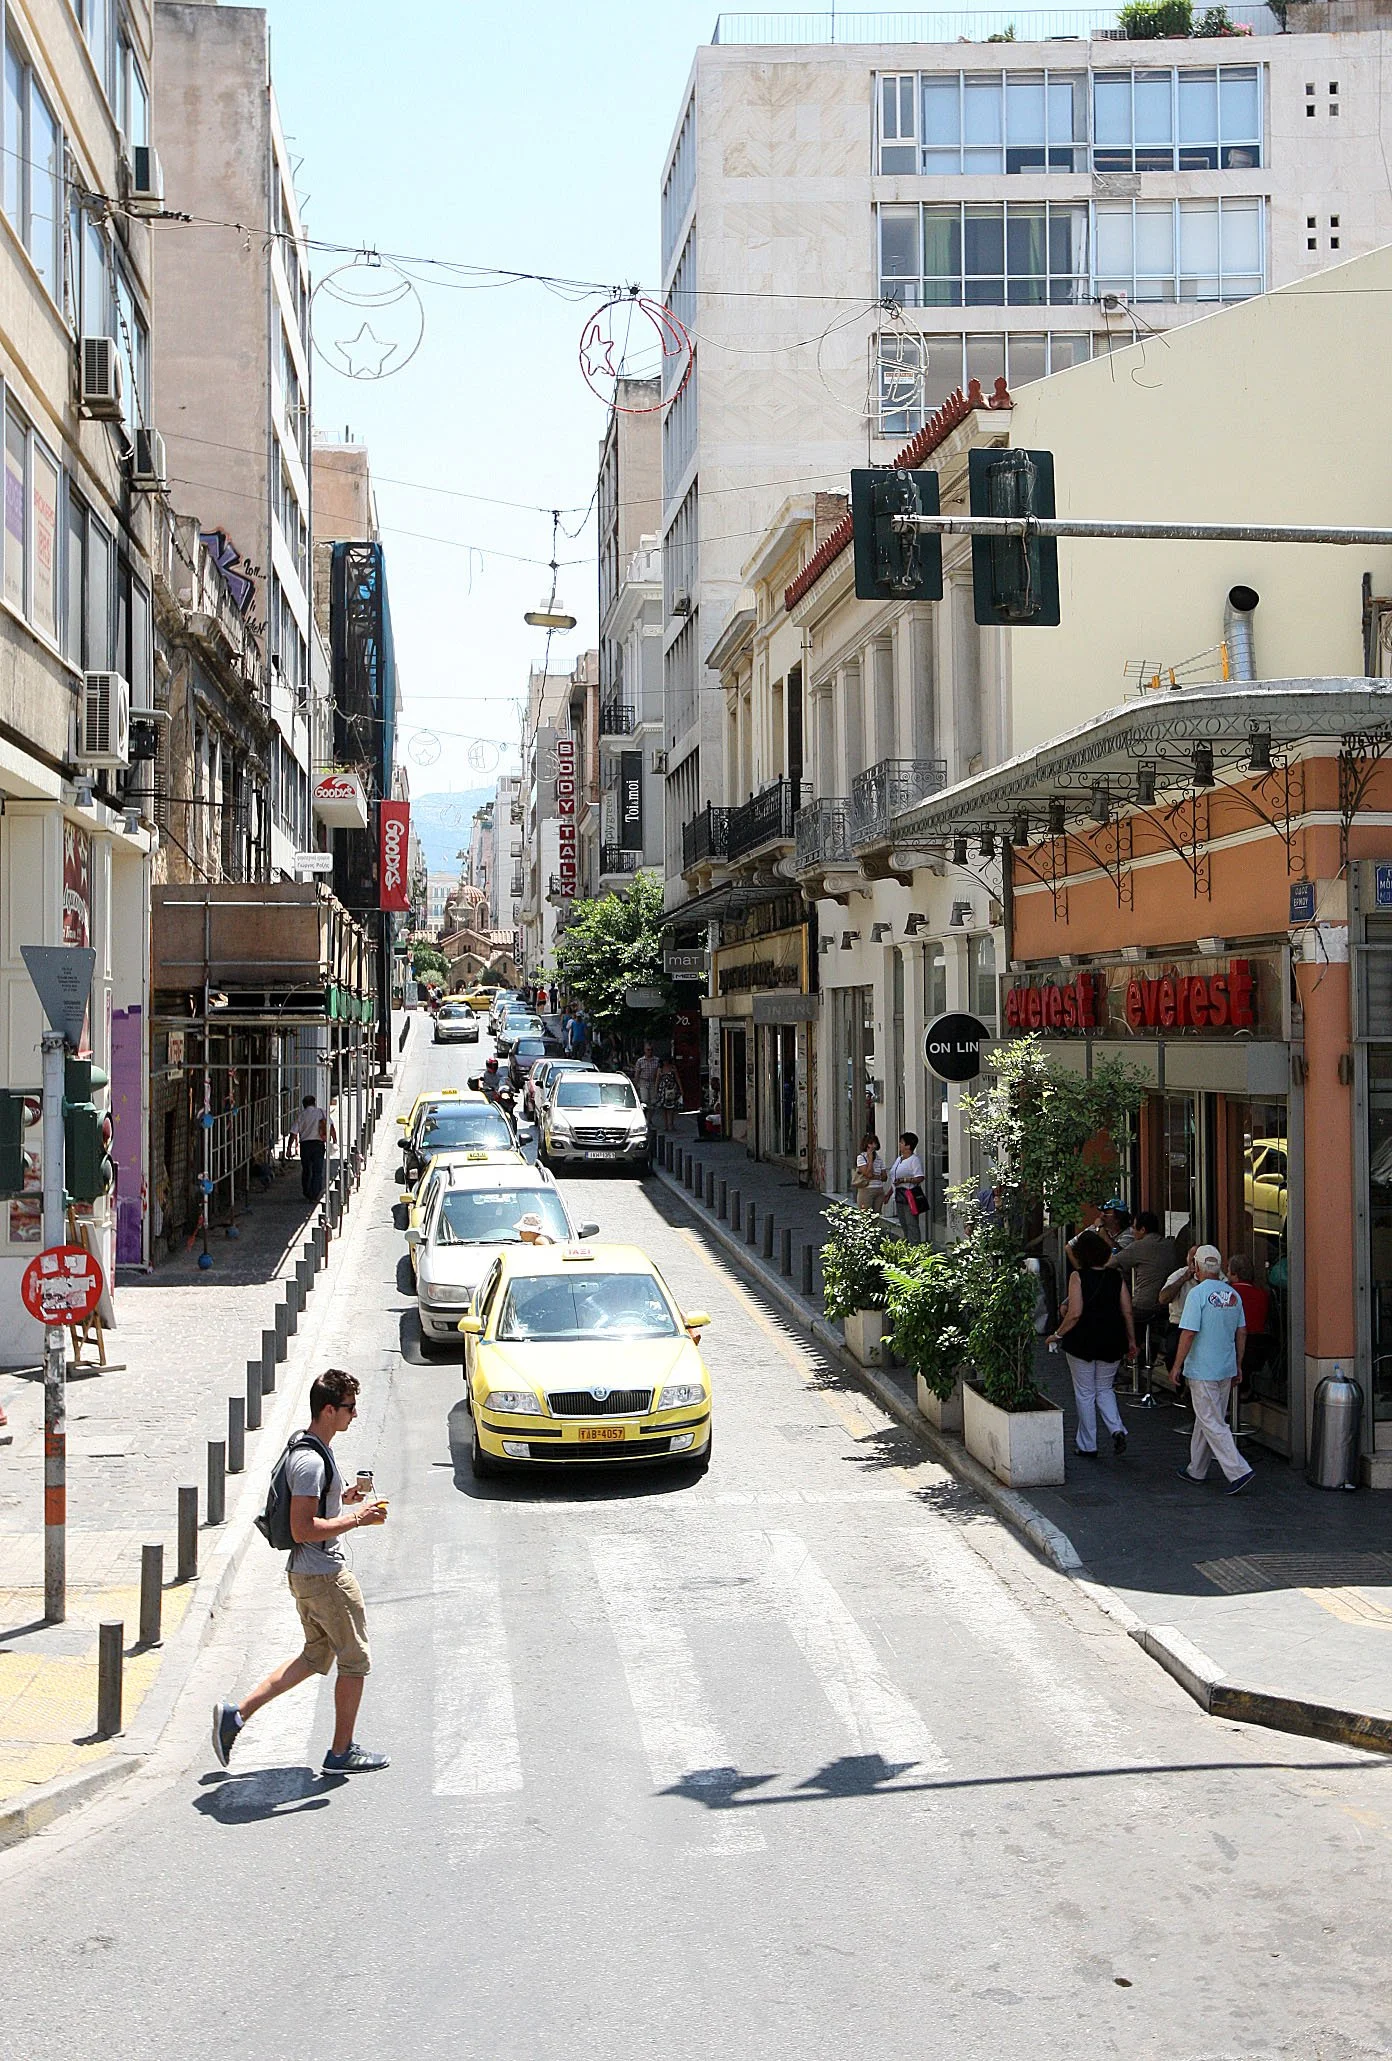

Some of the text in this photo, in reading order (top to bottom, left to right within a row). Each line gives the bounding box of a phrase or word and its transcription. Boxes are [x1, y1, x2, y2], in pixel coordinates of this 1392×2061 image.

[560, 826, 576, 896] TALK
[1007, 973, 1094, 1028] everest
[1126, 959, 1253, 1027] everest
[929, 1041, 979, 1054] ON LIN
